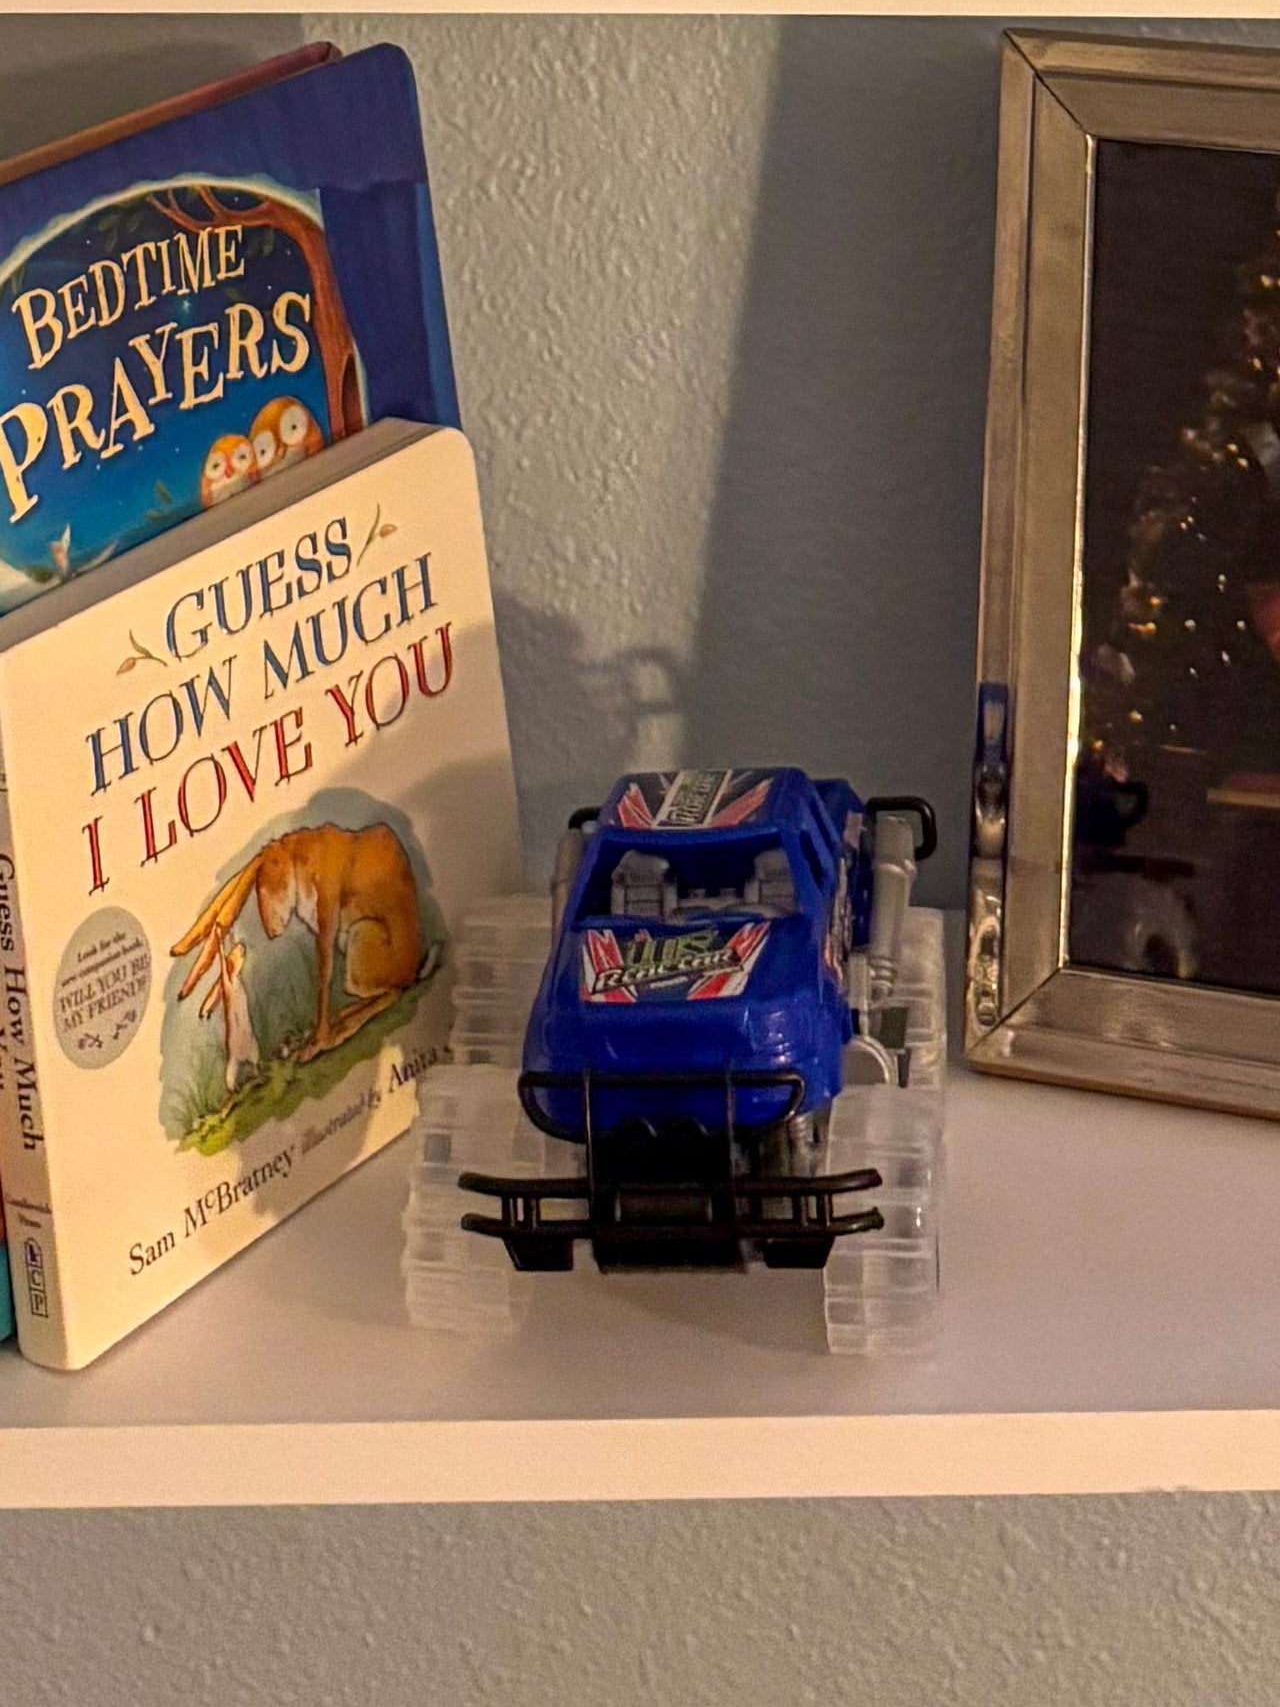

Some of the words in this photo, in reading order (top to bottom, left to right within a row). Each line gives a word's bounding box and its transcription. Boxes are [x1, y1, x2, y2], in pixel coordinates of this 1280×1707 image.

[11, 224, 246, 372] BEDTIME
[165, 515, 353, 662] GUESS
[84, 654, 239, 797] HOW
[262, 551, 439, 700] MUCH
[80, 815, 111, 898] I
[133, 706, 313, 868] LOVE
[324, 621, 454, 749] YOU
[4, 967, 28, 1045] How
[60, 983, 98, 1013] WILL
[98, 964, 128, 993] YOU
[13, 1057, 45, 1152] Much
[128, 1231, 176, 1276] Sam
[387, 1046, 438, 1094] Anita
